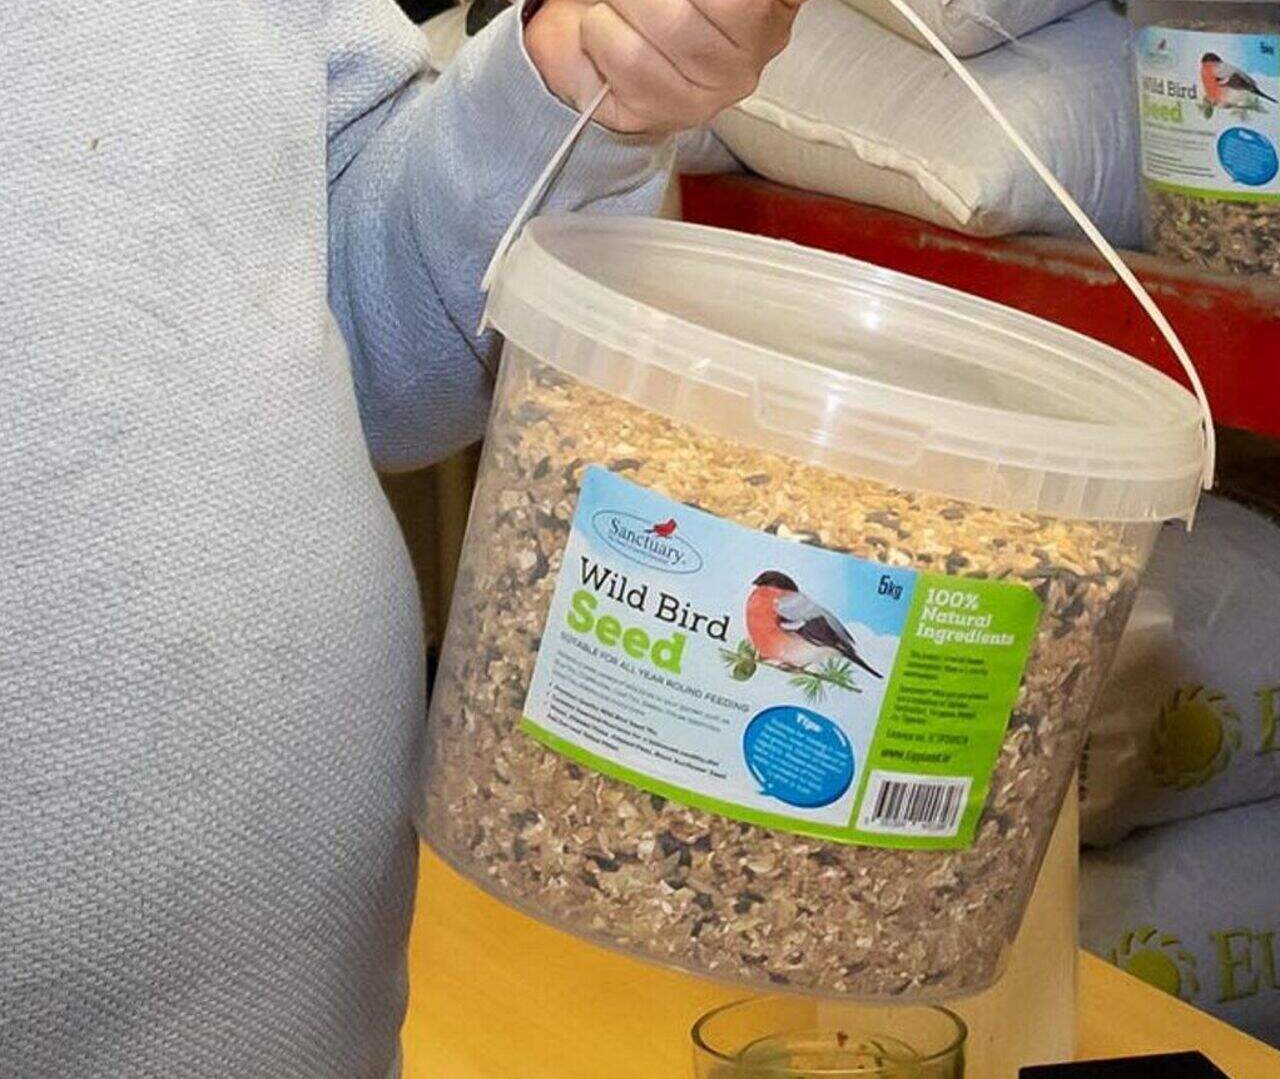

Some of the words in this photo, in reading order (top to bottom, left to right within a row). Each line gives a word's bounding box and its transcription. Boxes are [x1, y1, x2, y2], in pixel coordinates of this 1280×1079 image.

[1167, 80, 1198, 100] Bird
[609, 517, 685, 566] Sanctuary
[580, 556, 648, 612] Wild
[655, 592, 730, 642] Bird
[877, 574, 904, 600] 5kg
[926, 588, 980, 610] 100%
[921, 606, 992, 627] Natural
[566, 589, 687, 675] Seed
[916, 622, 1015, 645] Ingredients
[599, 650, 618, 667] FOR
[619, 658, 638, 675] ALL
[638, 667, 665, 684] YEAR
[704, 691, 750, 713] FEEDING
